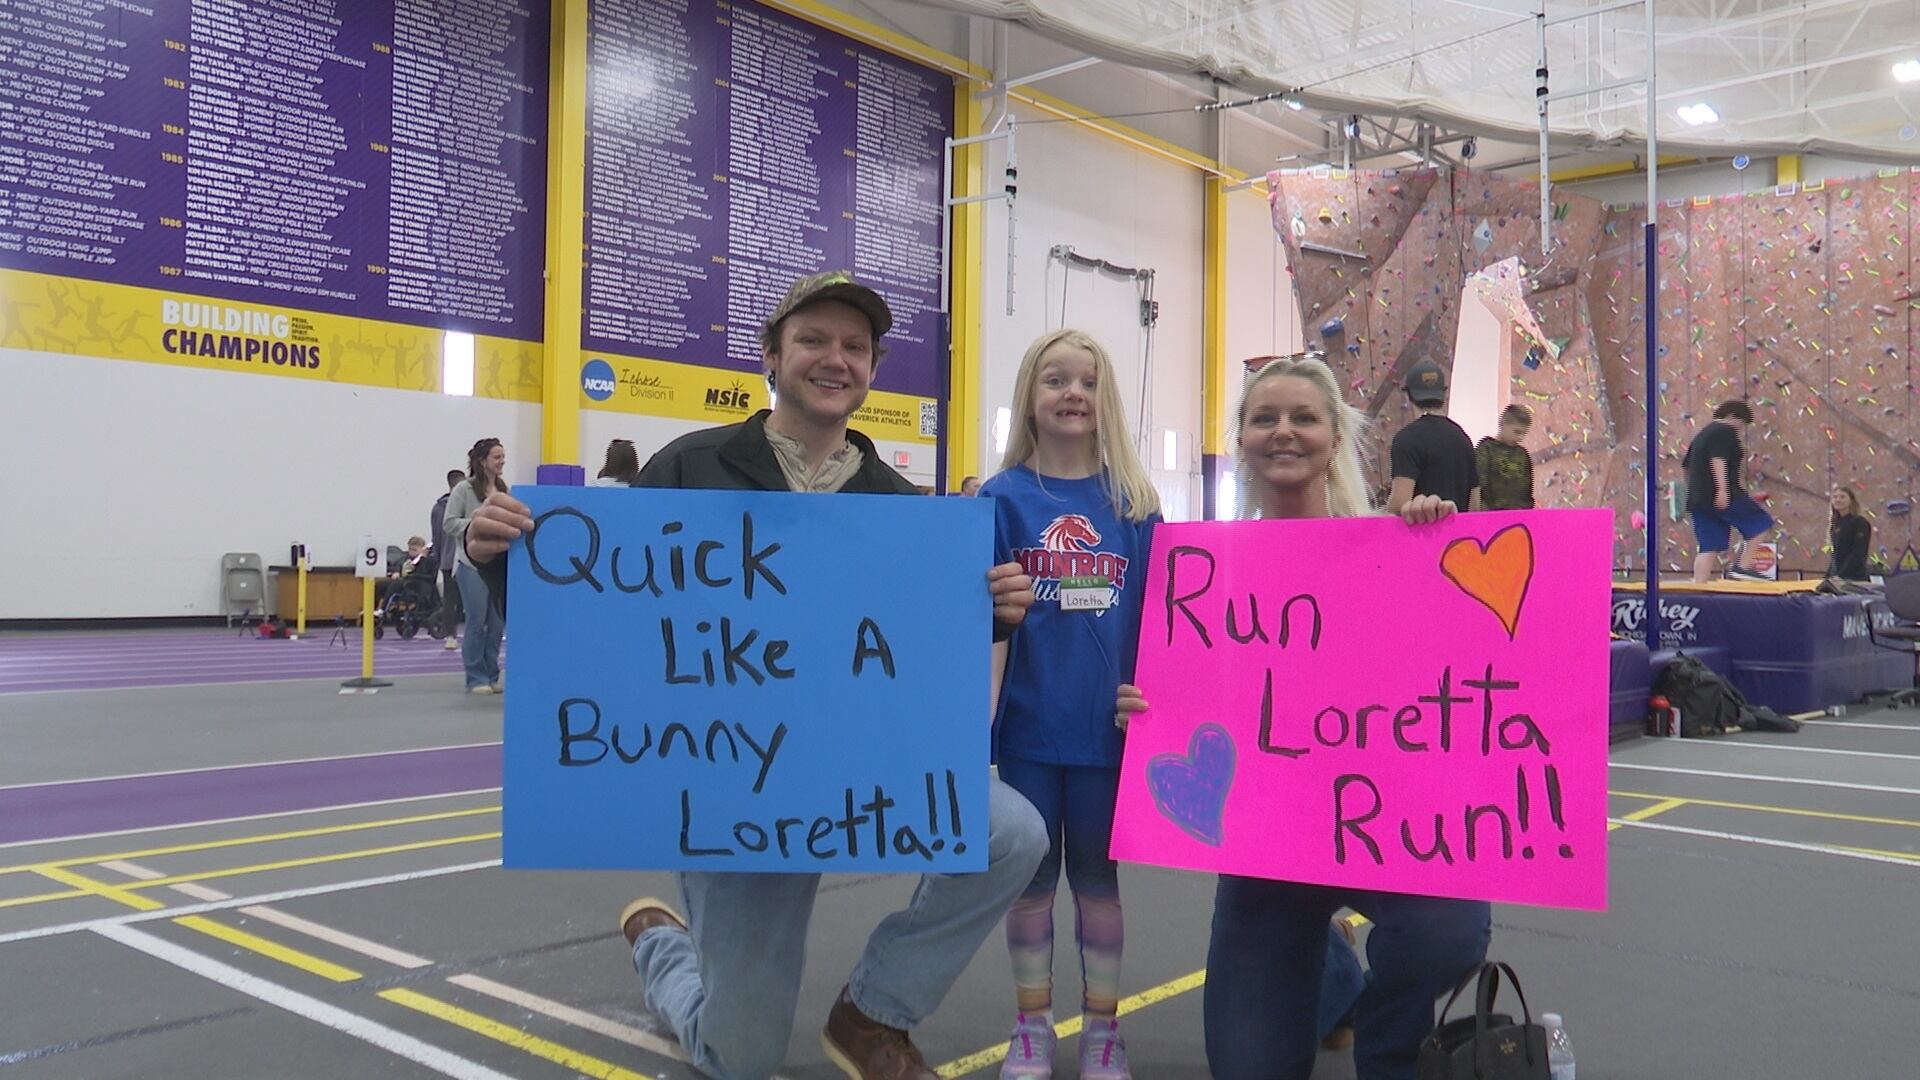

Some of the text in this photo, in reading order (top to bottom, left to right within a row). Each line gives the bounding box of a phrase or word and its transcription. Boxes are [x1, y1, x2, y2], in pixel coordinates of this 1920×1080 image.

[163, 124, 184, 136] 1984
[162, 152, 183, 164] 1985
[160, 265, 181, 277] 1987
[368, 265, 386, 275] 1990
[162, 299, 288, 338] BUILDING
[162, 328, 320, 369] CHAMPIONS
[584, 378, 615, 392] NCAA
[630, 385, 666, 400] Division
[873, 407, 901, 417] SPONSOR
[880, 416, 912, 427] ATHLETICS
[366, 548, 378, 566] 9
[526, 506, 787, 600] Quick
[1066, 593, 1105, 607] Loretta
[1165, 545, 1322, 650] Run
[660, 616, 896, 687] Like A
[1258, 663, 1551, 758] Loretta
[558, 698, 788, 793] Bunny
[680, 769, 967, 861] Loretta!!
[1333, 764, 1575, 865] Run!!
